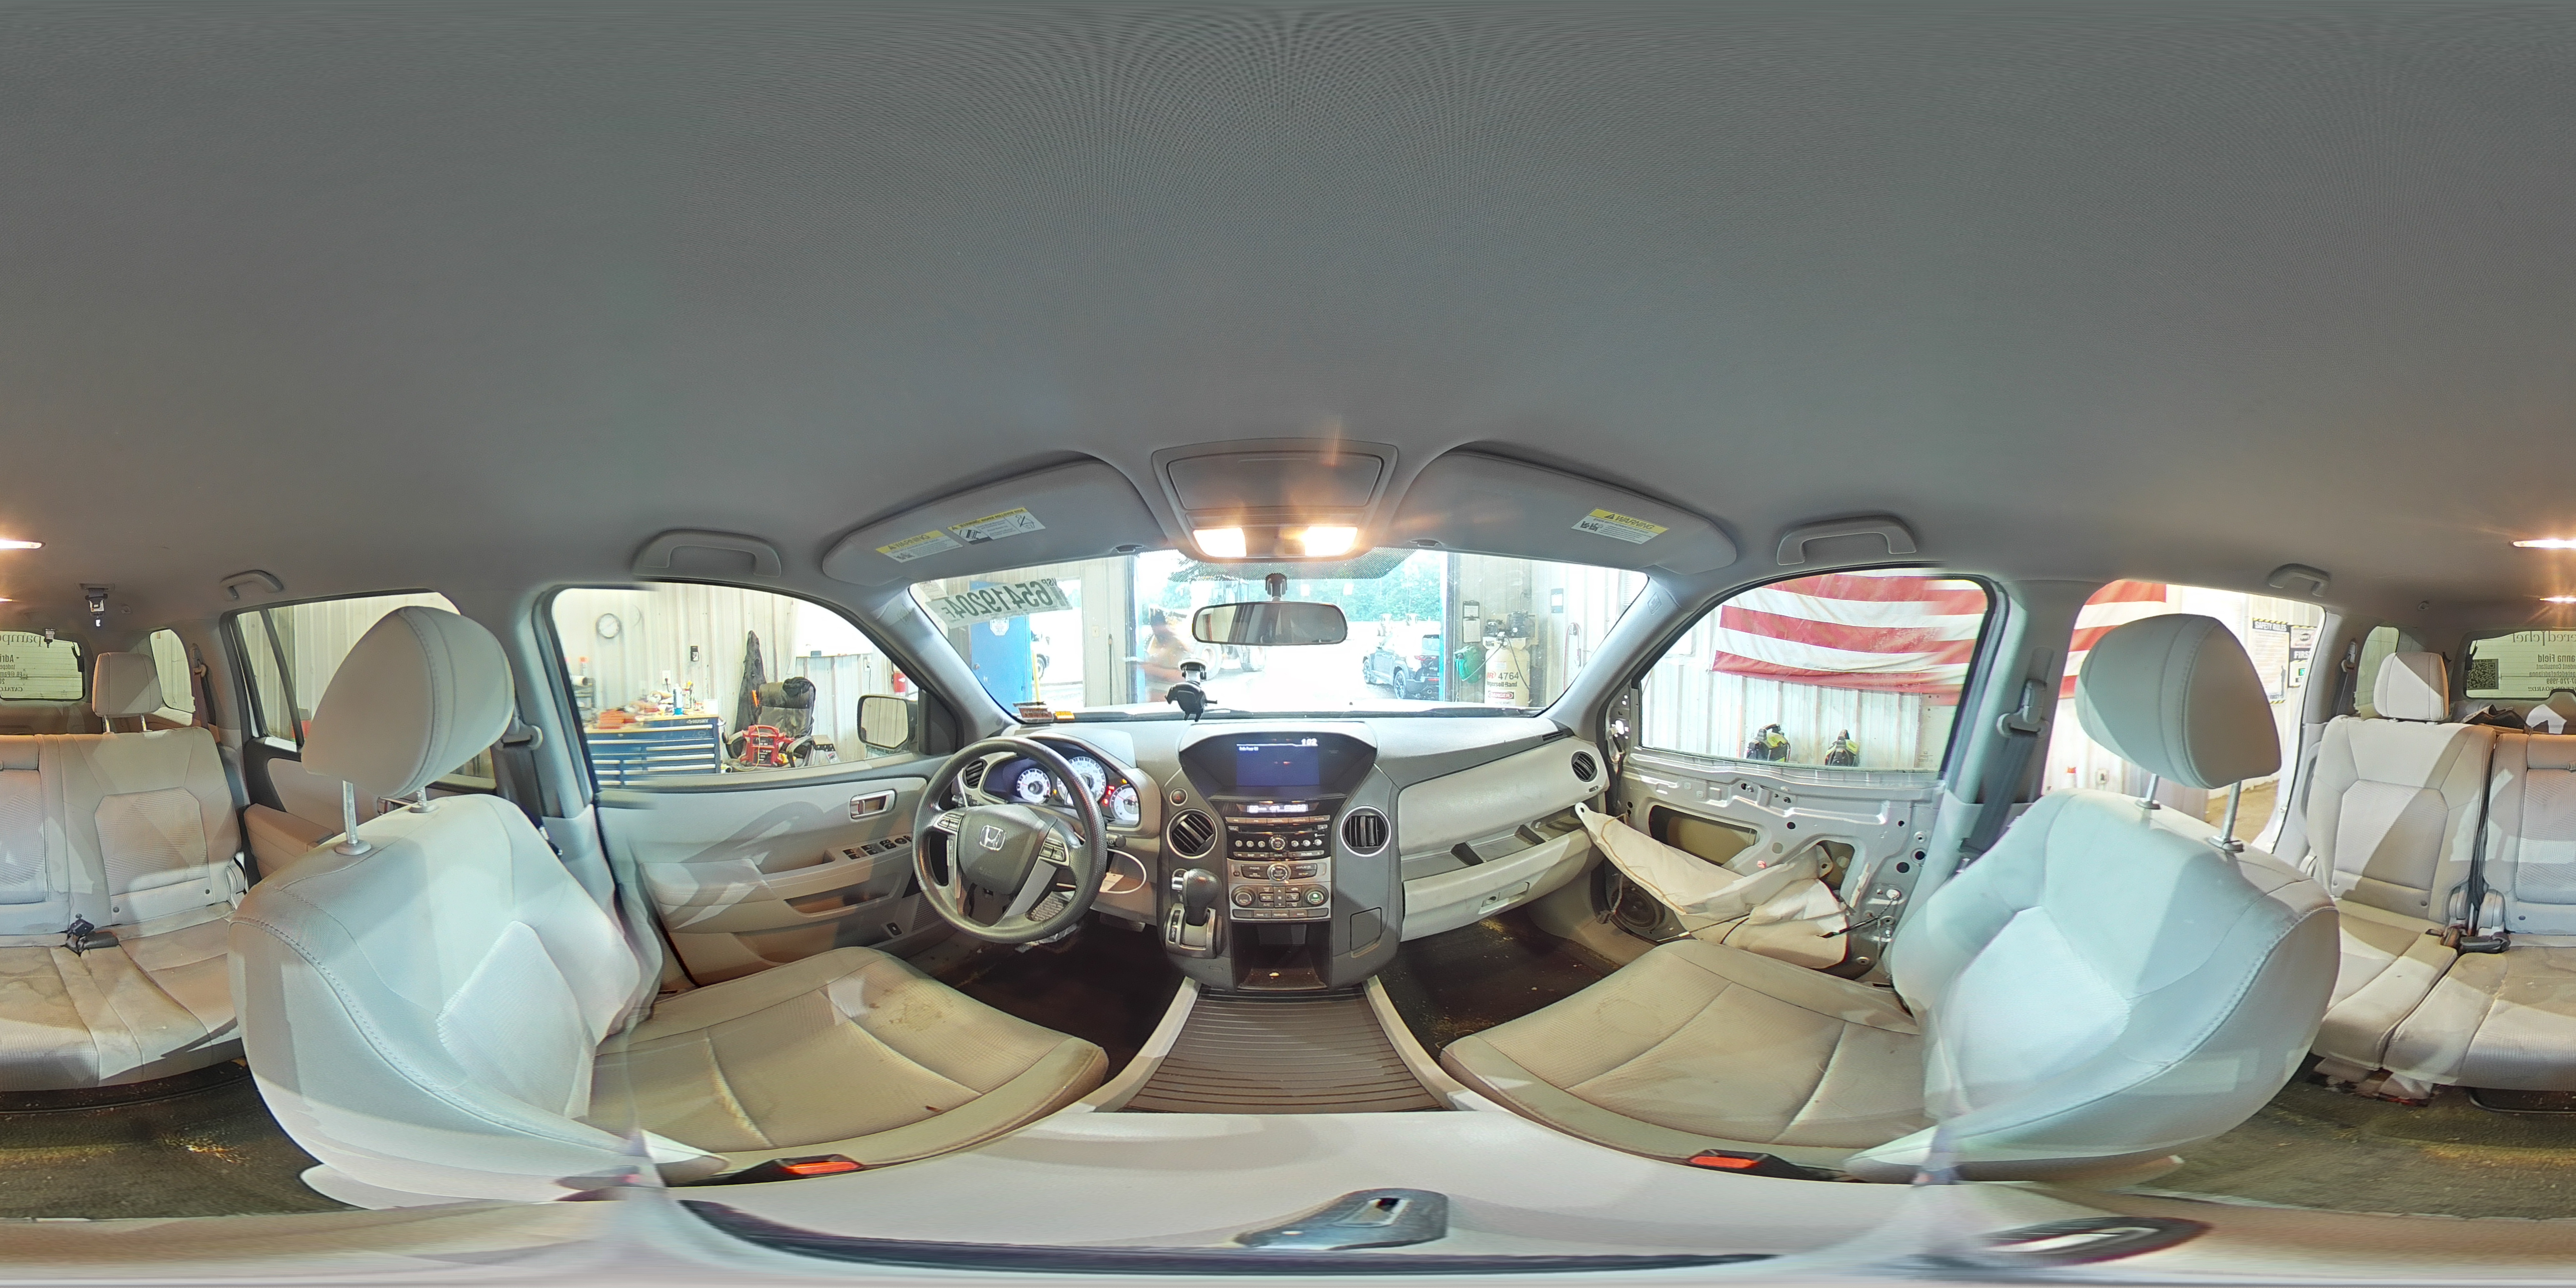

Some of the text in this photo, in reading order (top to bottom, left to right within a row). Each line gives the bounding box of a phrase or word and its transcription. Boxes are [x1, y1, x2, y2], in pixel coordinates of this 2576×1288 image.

[1615, 515, 1655, 529] WARNING
[894, 534, 931, 548] WARNING
[2254, 621, 2272, 630] SAFETY
[2294, 651, 2310, 659] FIRS
[1498, 672, 1519, 680] 4764
